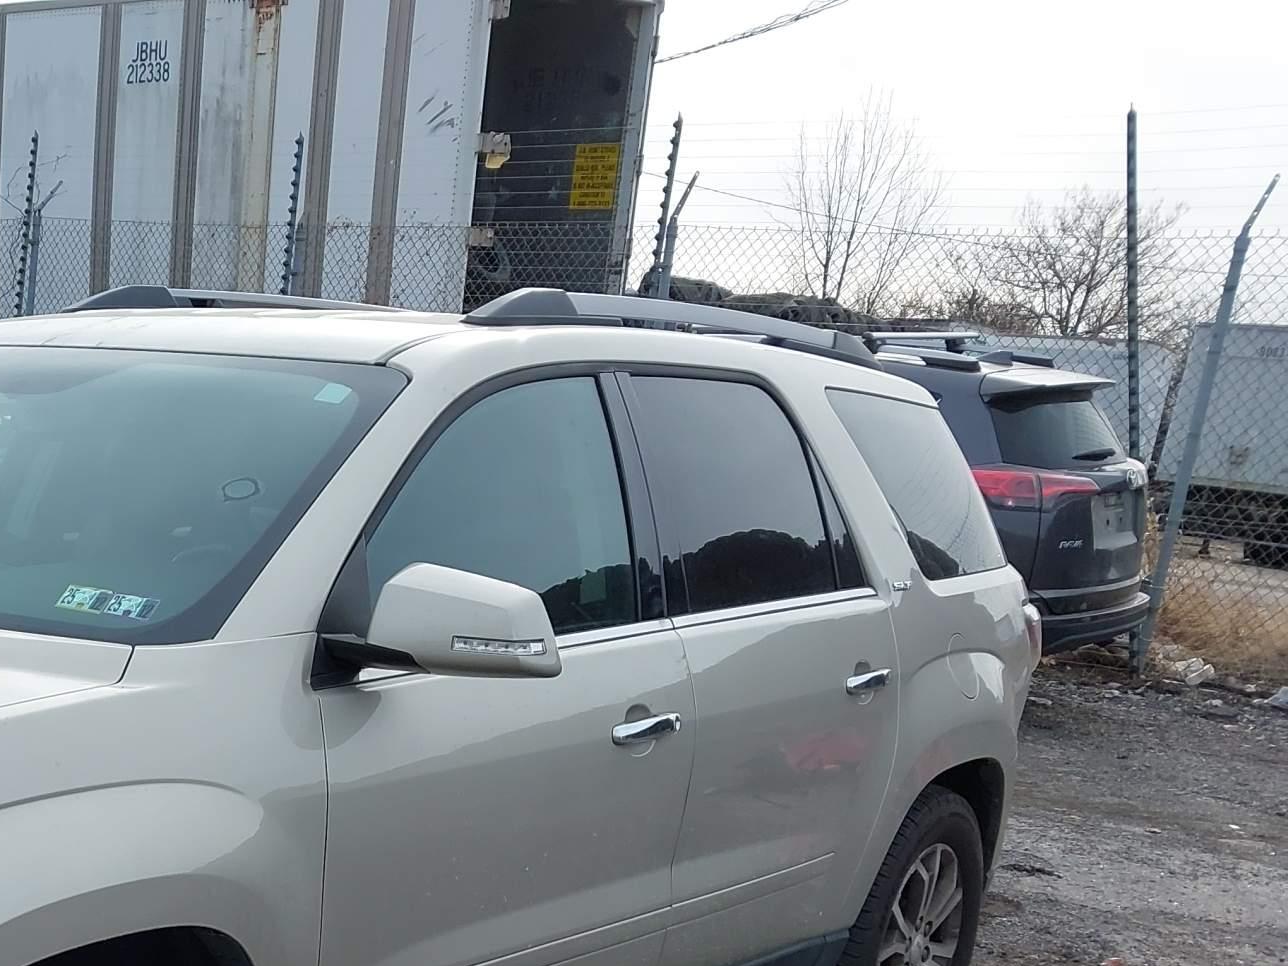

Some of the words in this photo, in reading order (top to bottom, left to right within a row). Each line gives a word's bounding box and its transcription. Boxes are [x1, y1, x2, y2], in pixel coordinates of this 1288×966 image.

[132, 40, 168, 63] JBHU
[127, 61, 170, 84] 212338
[60, 588, 81, 605] 25
[108, 595, 126, 613] 25
